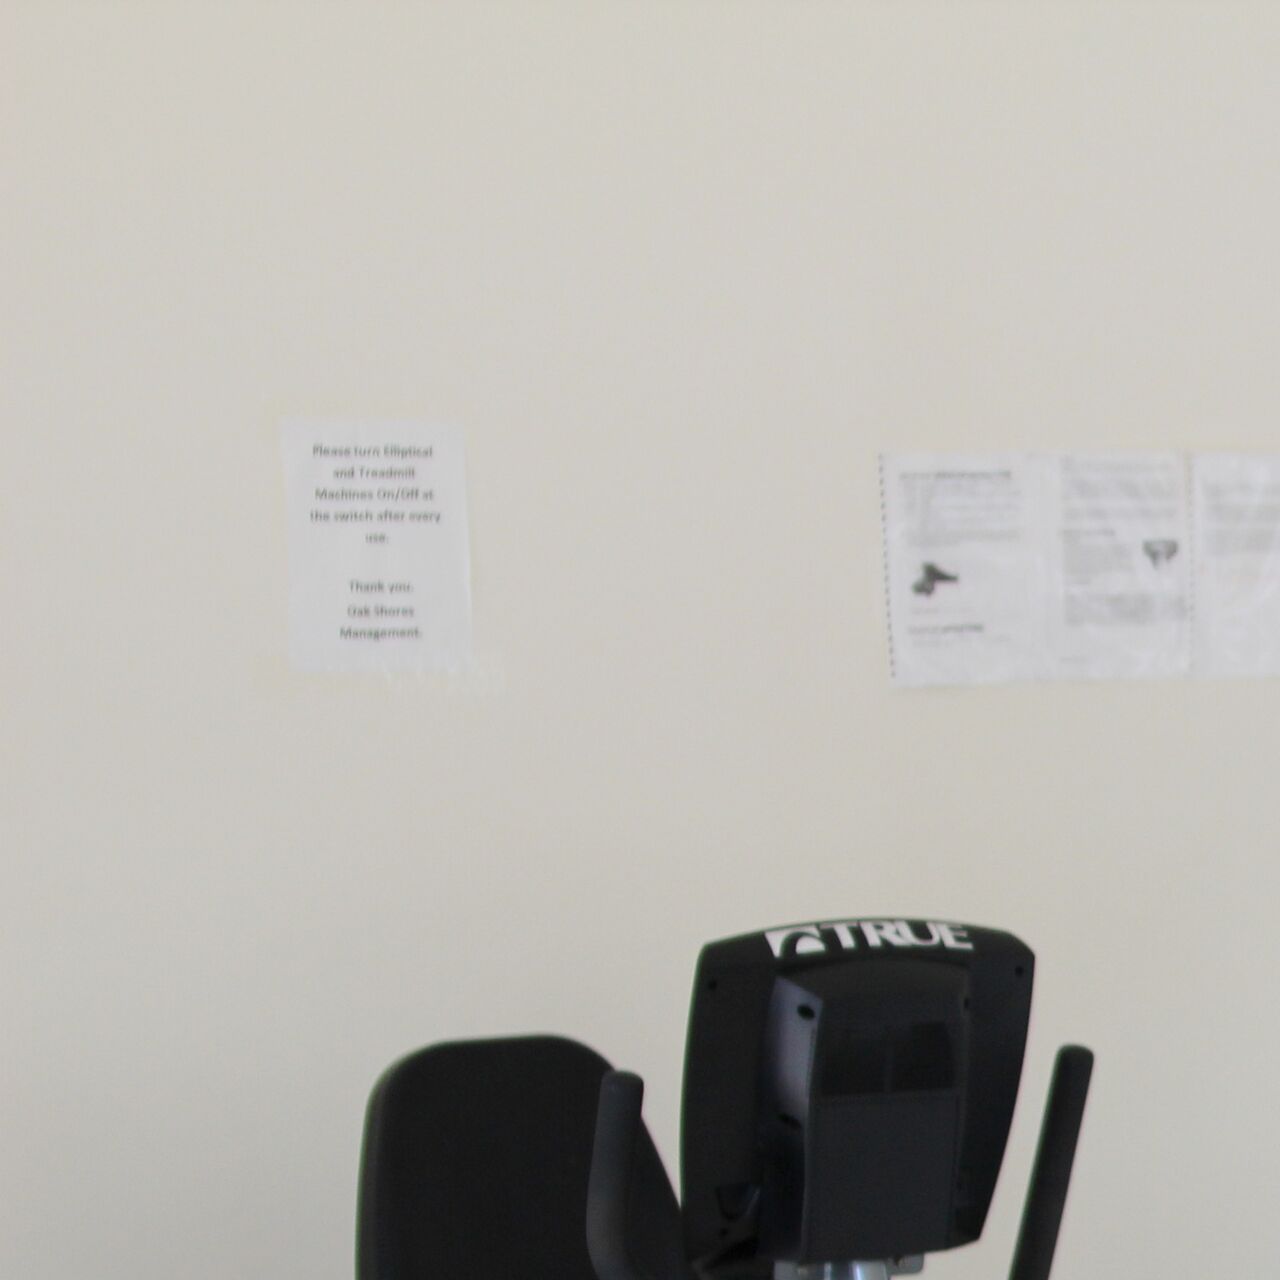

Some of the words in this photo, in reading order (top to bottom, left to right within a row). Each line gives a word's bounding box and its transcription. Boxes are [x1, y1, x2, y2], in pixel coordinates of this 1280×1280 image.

[313, 443, 351, 457] Please
[354, 445, 380, 457] turn
[384, 444, 433, 459] Elliptical
[333, 467, 355, 478] and
[360, 467, 415, 478] Treadmill
[315, 488, 373, 500] Machines
[377, 488, 419, 501] On/Off
[423, 489, 433, 500] at
[310, 510, 329, 521] the
[334, 510, 373, 521] switch
[377, 510, 404, 521] after
[409, 512, 440, 523] every
[350, 580, 384, 592] Thank
[347, 605, 370, 617] Oak
[374, 605, 414, 618] Shores
[820, 919, 974, 950] TRUE
